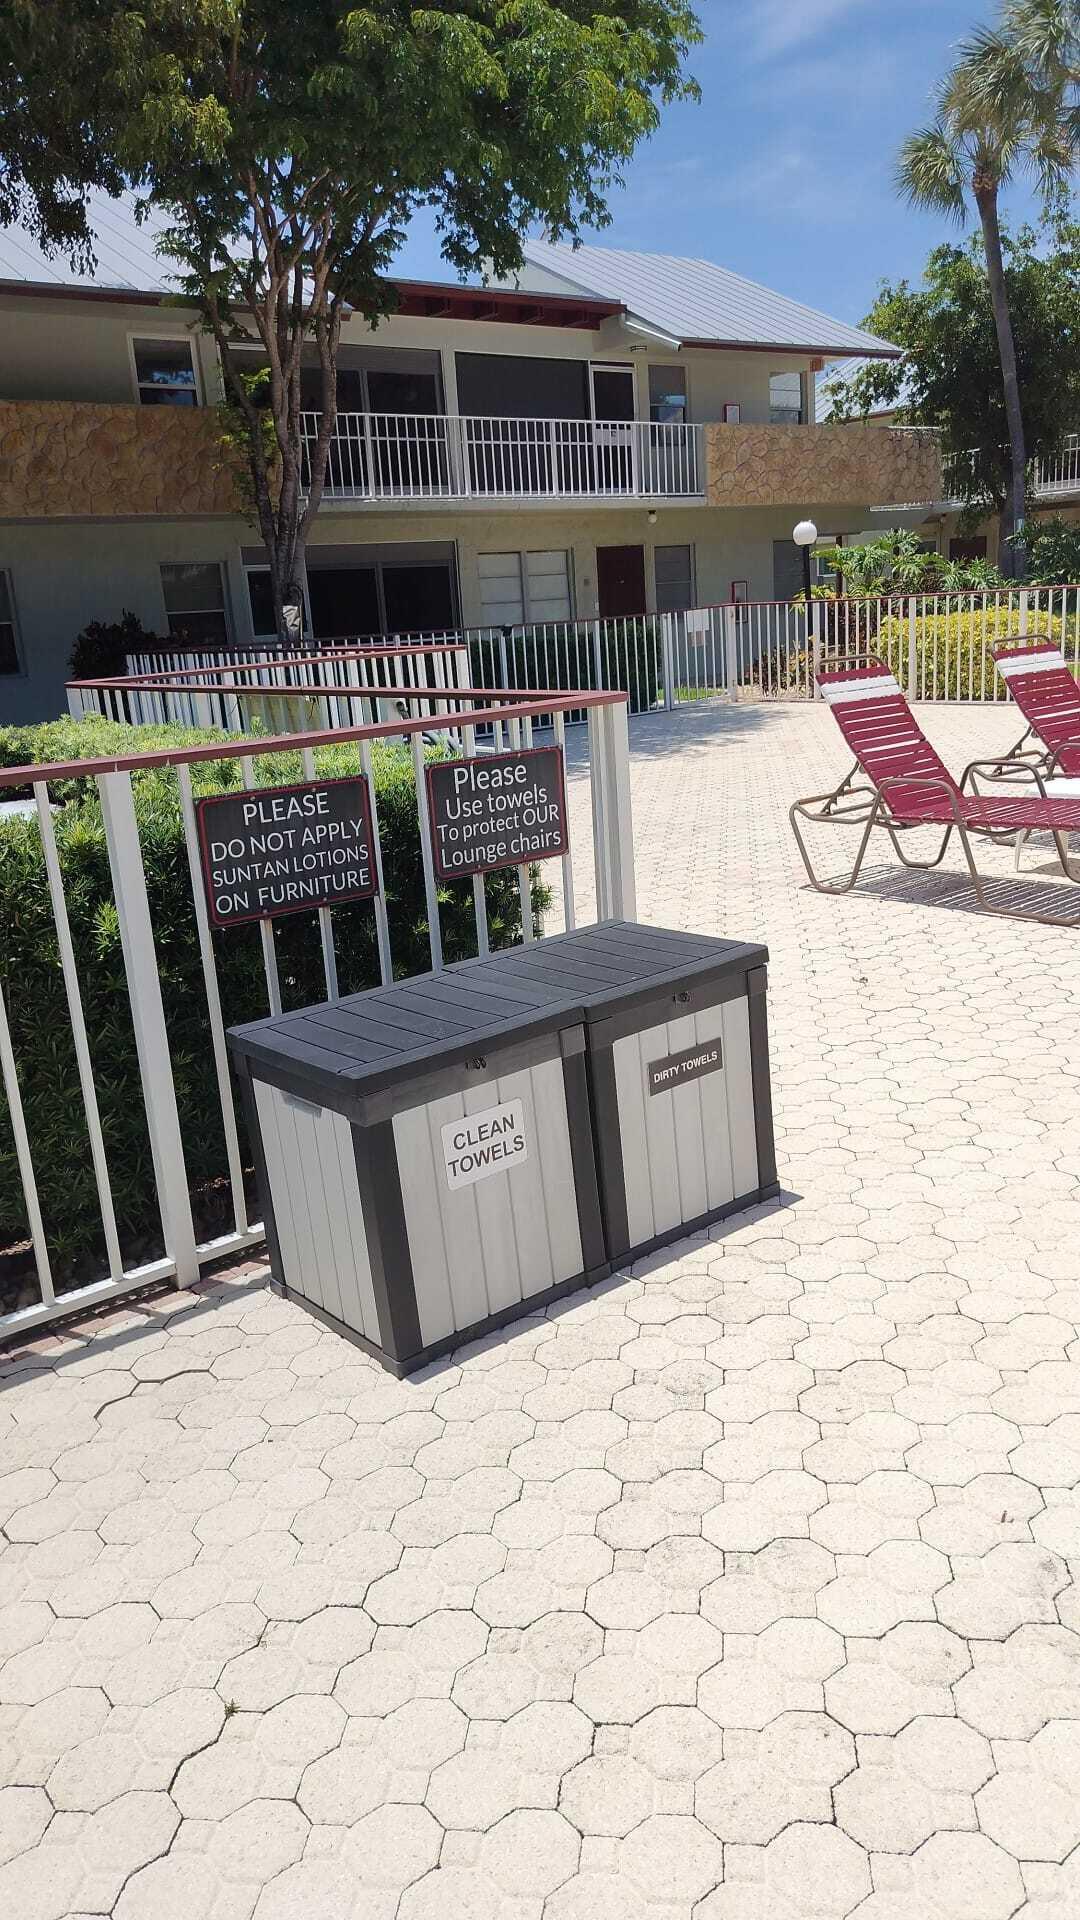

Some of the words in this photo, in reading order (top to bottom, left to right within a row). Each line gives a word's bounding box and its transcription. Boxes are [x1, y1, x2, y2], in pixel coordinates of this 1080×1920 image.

[454, 764, 527, 794] Please
[243, 791, 330, 826] PLEASE
[446, 797, 483, 820] Use
[487, 783, 548, 813] towels
[211, 838, 245, 862] DO
[250, 829, 296, 856] NOT
[301, 818, 363, 846] APPLY
[436, 824, 459, 843] To
[462, 812, 520, 842] protect
[522, 804, 560, 826] OUR
[212, 858, 290, 887] SUNTAN
[293, 844, 369, 873] LOTIONS
[441, 842, 507, 868] Lounge
[510, 829, 561, 854] chairs
[215, 891, 249, 914] ON
[257, 868, 371, 906] FURNITURE
[653, 1065, 680, 1084] DIRTY
[681, 1050, 718, 1073] TOWELS
[452, 1113, 515, 1150] CLEAN
[447, 1134, 525, 1177] TOWELS
